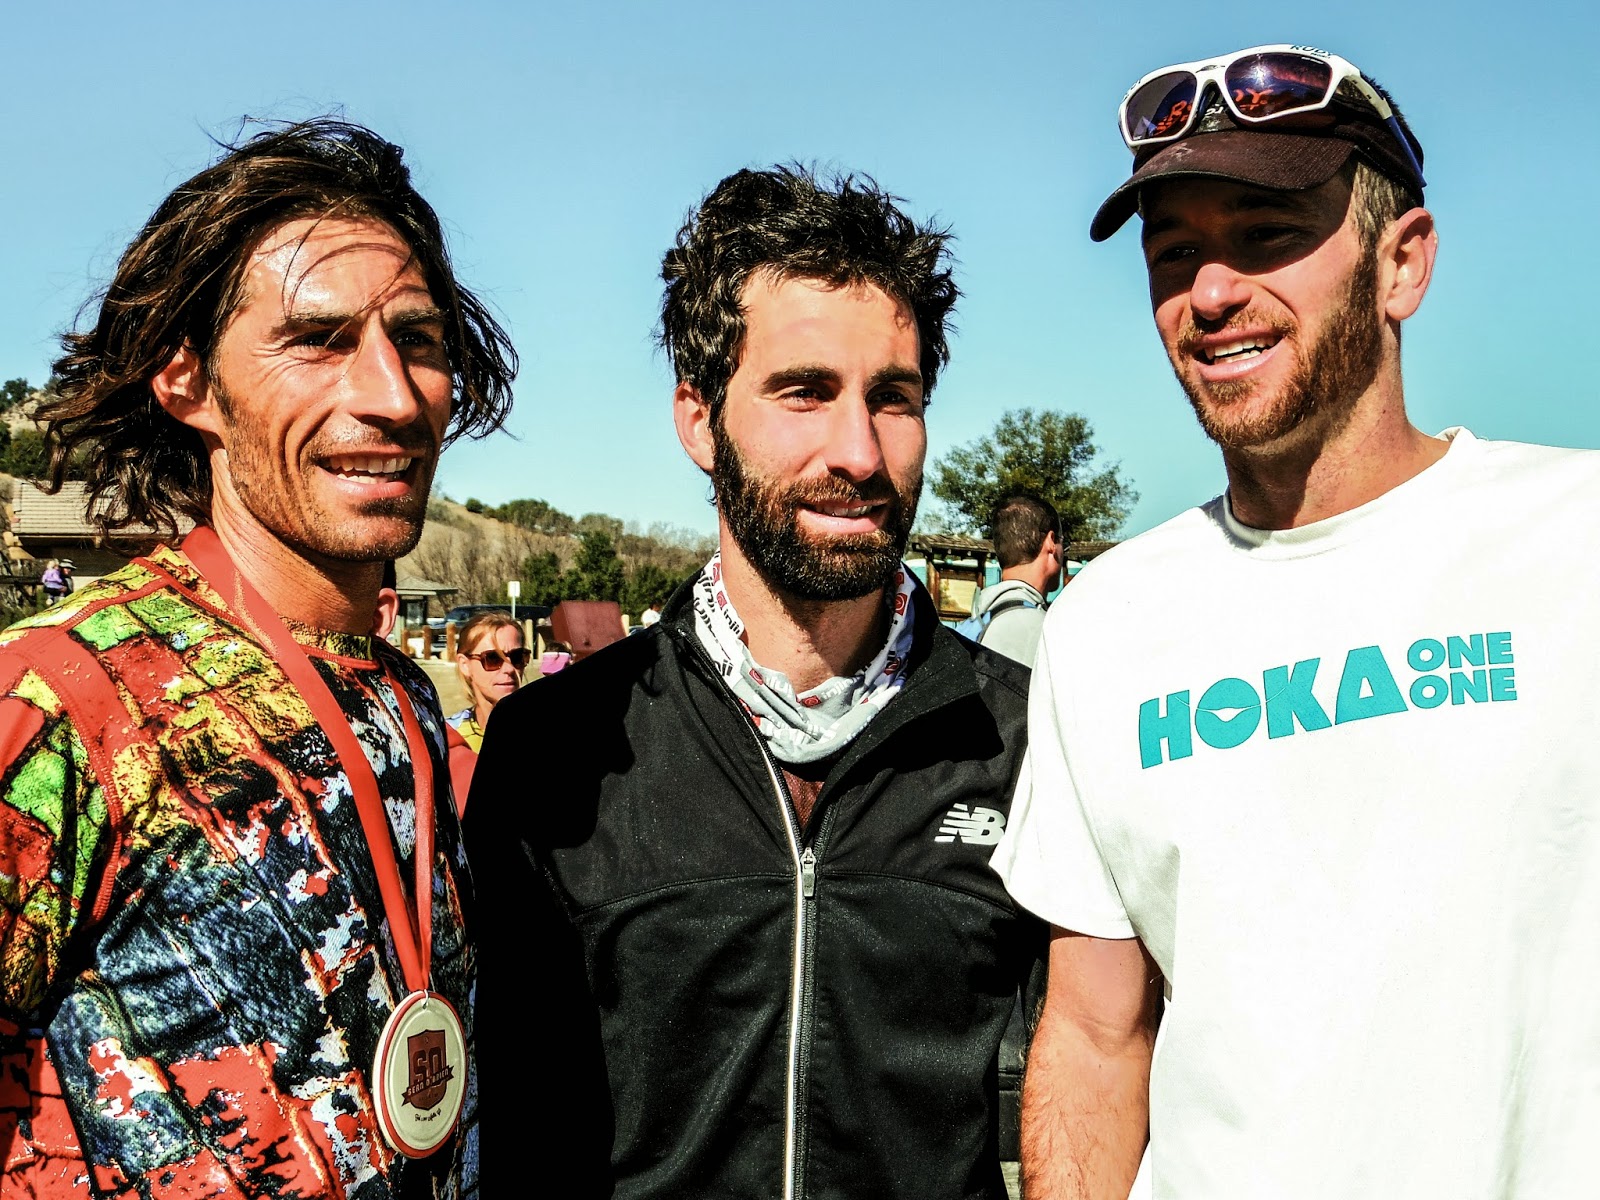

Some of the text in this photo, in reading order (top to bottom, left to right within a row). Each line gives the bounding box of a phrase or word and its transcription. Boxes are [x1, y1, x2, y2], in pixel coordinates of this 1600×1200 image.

[1138, 632, 1514, 770] HOKA ONE
[1409, 668, 1518, 709] ONE
[407, 1081, 425, 1096] SEAN
